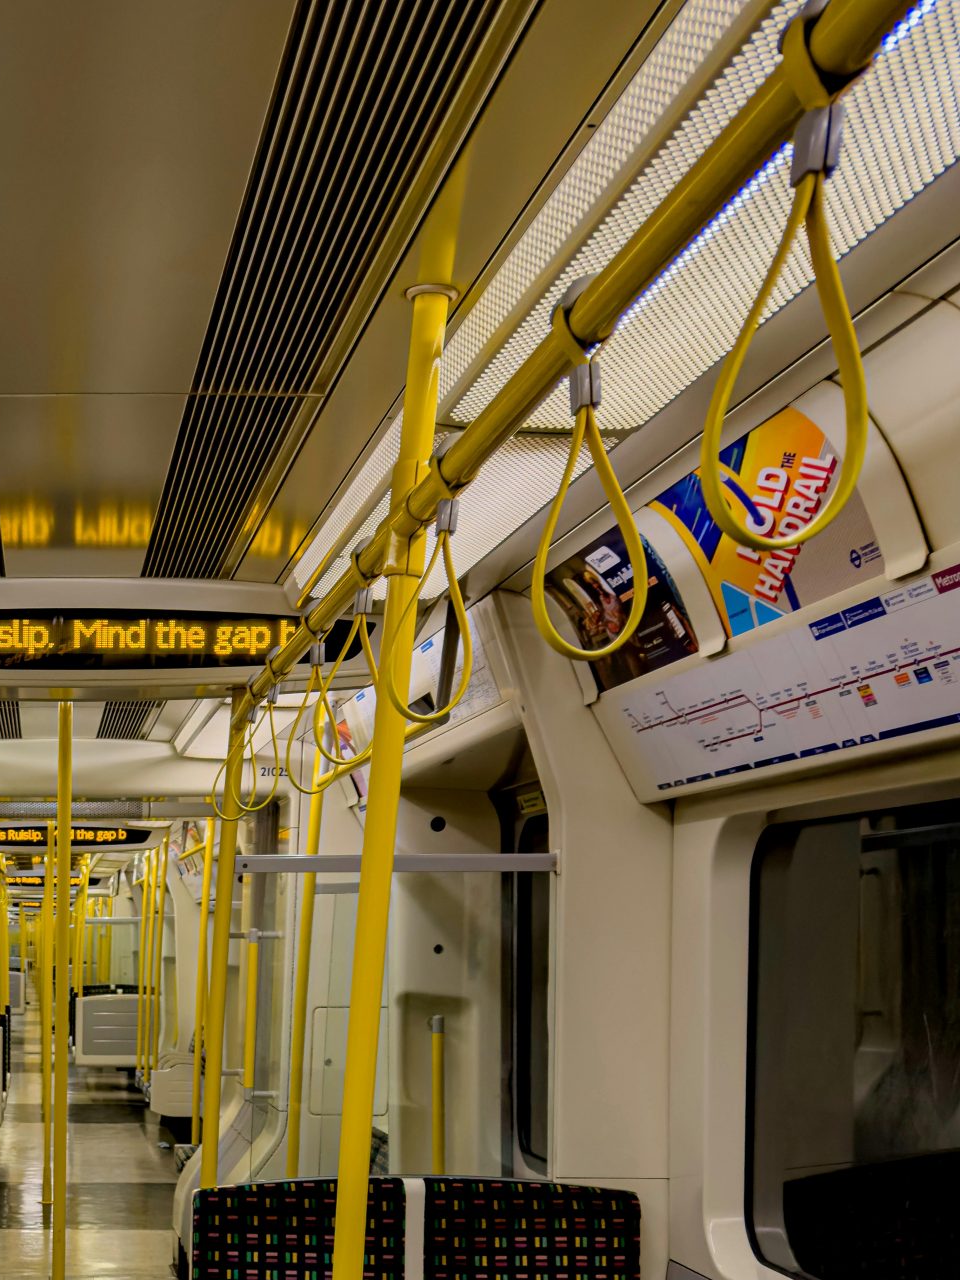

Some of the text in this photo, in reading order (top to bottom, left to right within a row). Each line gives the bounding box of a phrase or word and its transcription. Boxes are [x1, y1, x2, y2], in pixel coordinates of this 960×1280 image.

[781, 452, 796, 469] THE
[73, 619, 146, 649] Mind
[156, 619, 206, 649] the
[214, 626, 271, 655] gap
[7, 829, 43, 843] Ruislip.
[76, 828, 94, 840] the
[96, 830, 117, 842] gap
[118, 829, 127, 839] b
